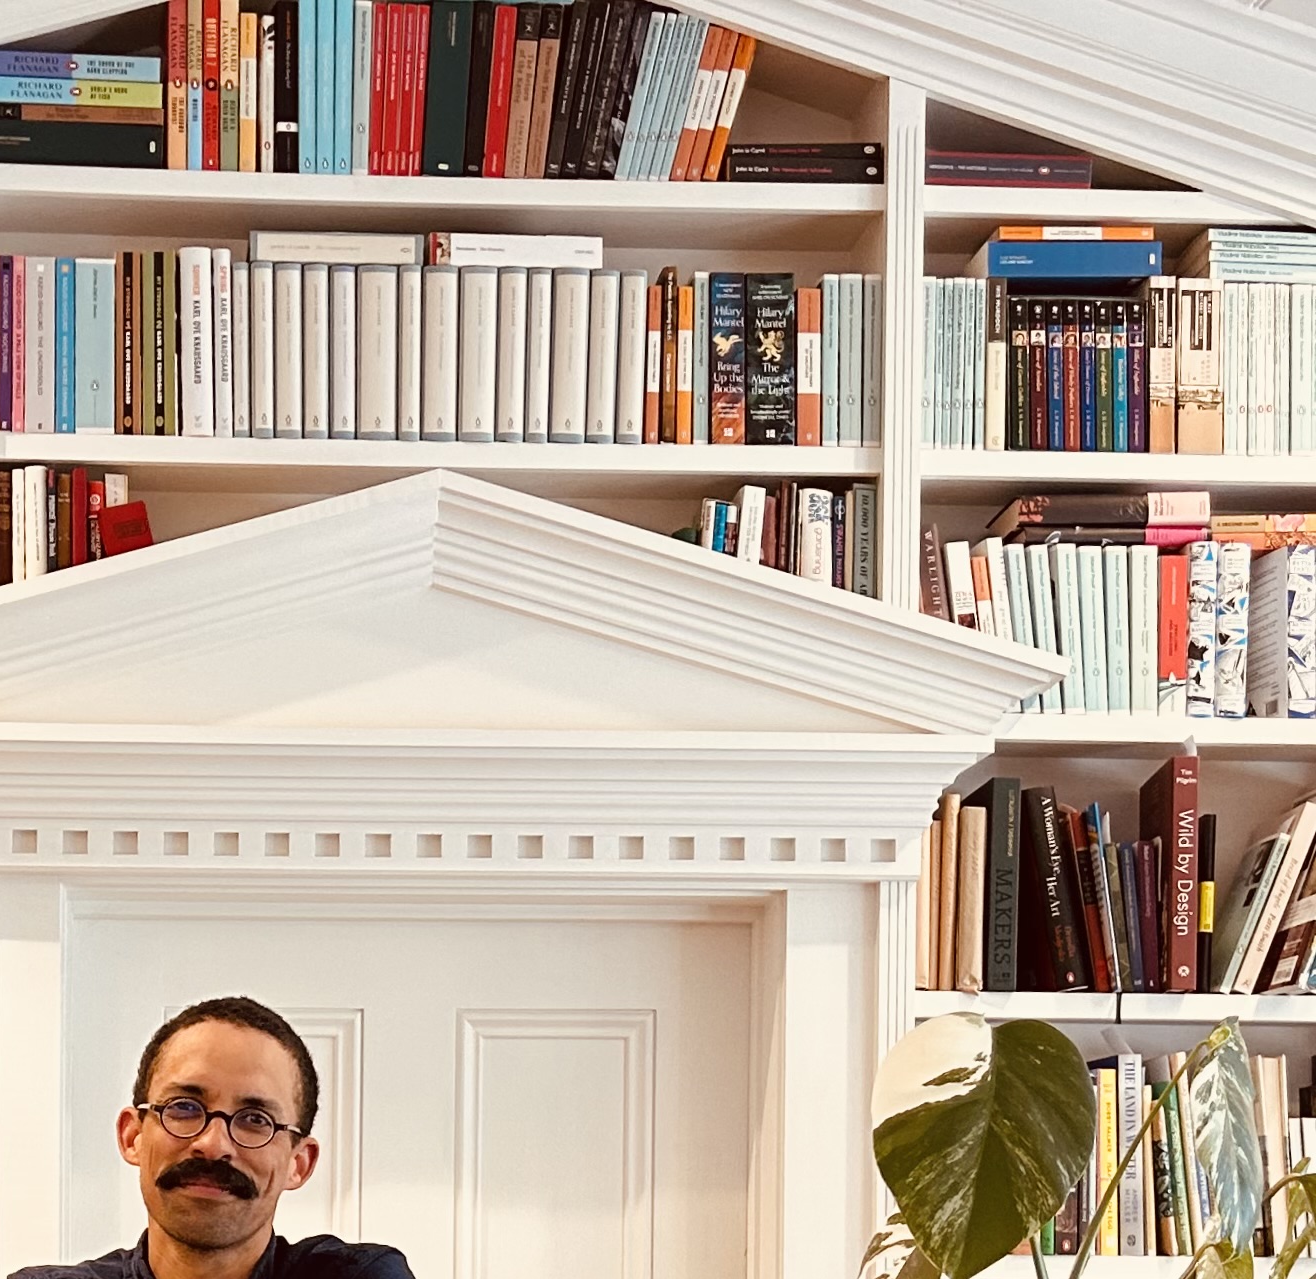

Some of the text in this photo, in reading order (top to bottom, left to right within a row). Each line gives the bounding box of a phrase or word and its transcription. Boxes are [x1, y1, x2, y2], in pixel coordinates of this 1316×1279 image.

[713, 318, 744, 327] Mantel
[715, 306, 741, 317] Hilary
[1173, 810, 1194, 937] Wild by Design
[994, 868, 1014, 965] MAKERS
